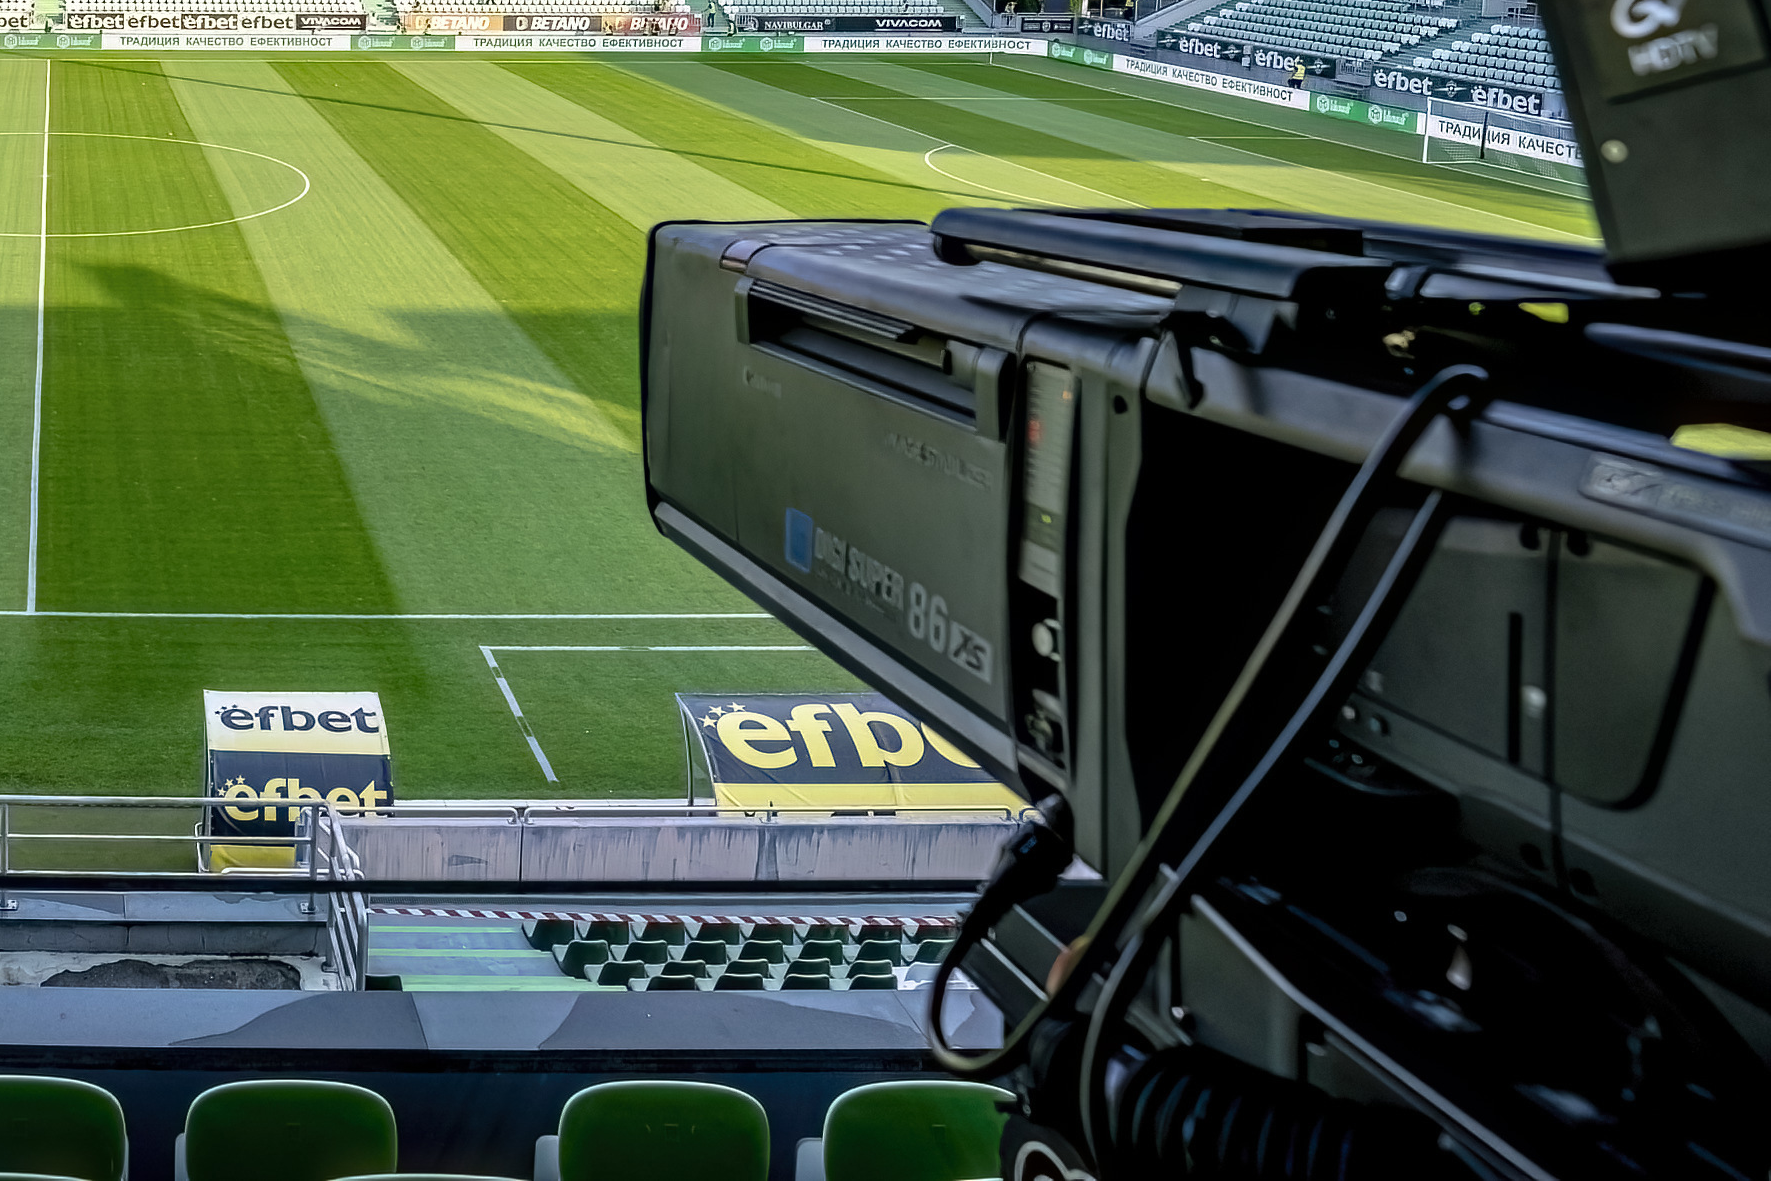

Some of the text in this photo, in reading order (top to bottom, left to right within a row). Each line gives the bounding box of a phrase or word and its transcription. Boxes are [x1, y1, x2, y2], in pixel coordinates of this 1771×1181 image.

[69, 14, 293, 29] efbet efbet efbet efbet
[300, 17, 362, 26] VIVACOM
[429, 16, 490, 30] BETANO
[531, 16, 590, 30] BETANO
[876, 19, 942, 28] VIVACOM
[120, 36, 333, 47] ТРАДИЦИЯ КАЧЕСТВО ЕФЕКТИВНОСТ
[473, 38, 684, 48] ТРАДИЦИЯ КАЧЕСТВО ЕФЕКТИВНОСТ
[822, 39, 1032, 50] ТРАДИЦИЯ КАЧЕСТВО ЕФЕКТИВНОСТ
[1179, 37, 1222, 59] efbet
[1125, 59, 1168, 77] ТРАДИЦИЯ
[1172, 69, 1218, 87] КАЧЕСТВО
[1222, 79, 1293, 103] ЕФЕКТИВНОСТ
[1373, 69, 1540, 115] efbet efbet
[908, 580, 950, 654] 86
[215, 704, 380, 733] efbet
[217, 775, 388, 822] efbet
